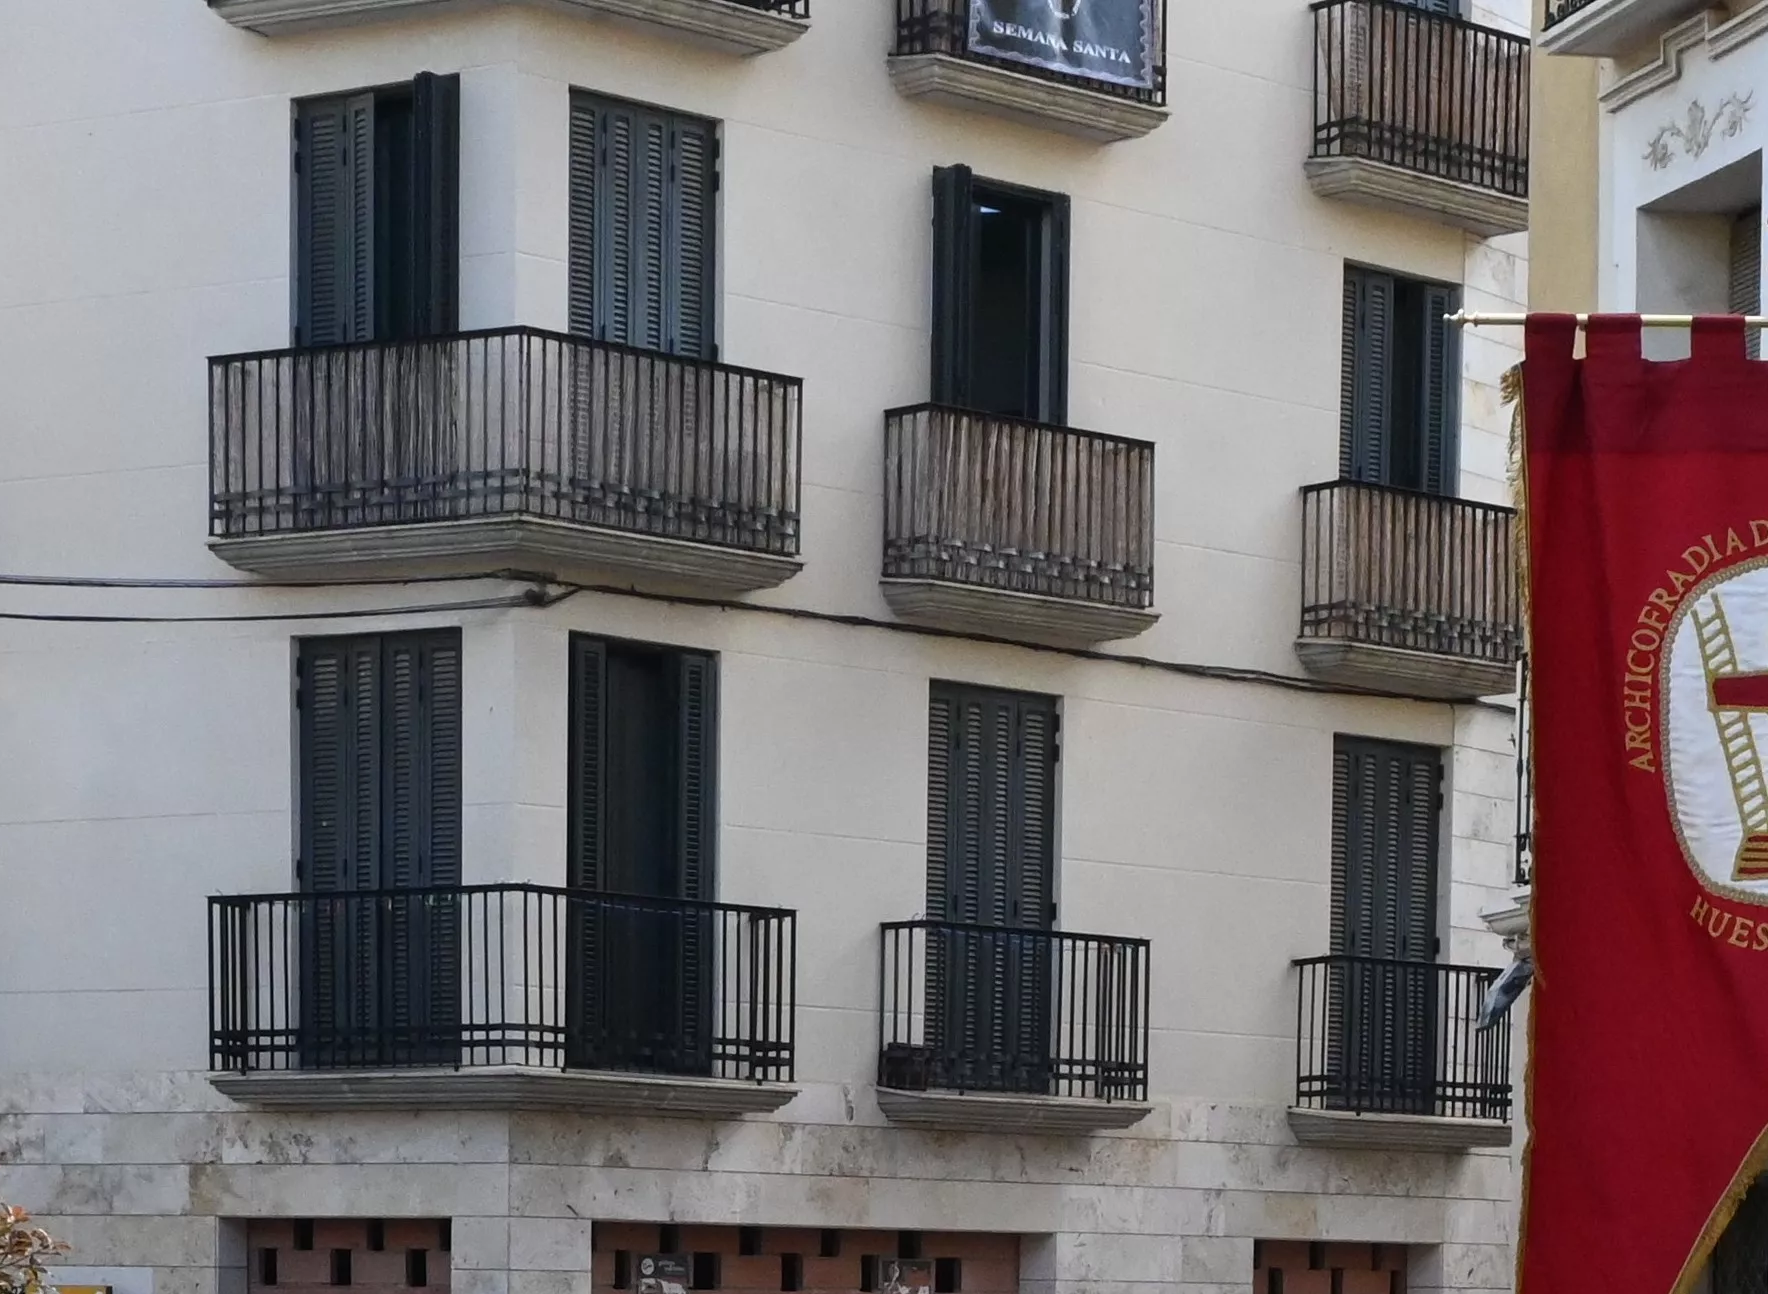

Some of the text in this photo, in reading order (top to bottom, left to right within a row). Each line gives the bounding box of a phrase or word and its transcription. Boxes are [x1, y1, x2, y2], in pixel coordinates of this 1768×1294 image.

[993, 20, 1131, 64] SEMANA SANTA
[1623, 526, 1748, 774] ARCHICOFRADIA
